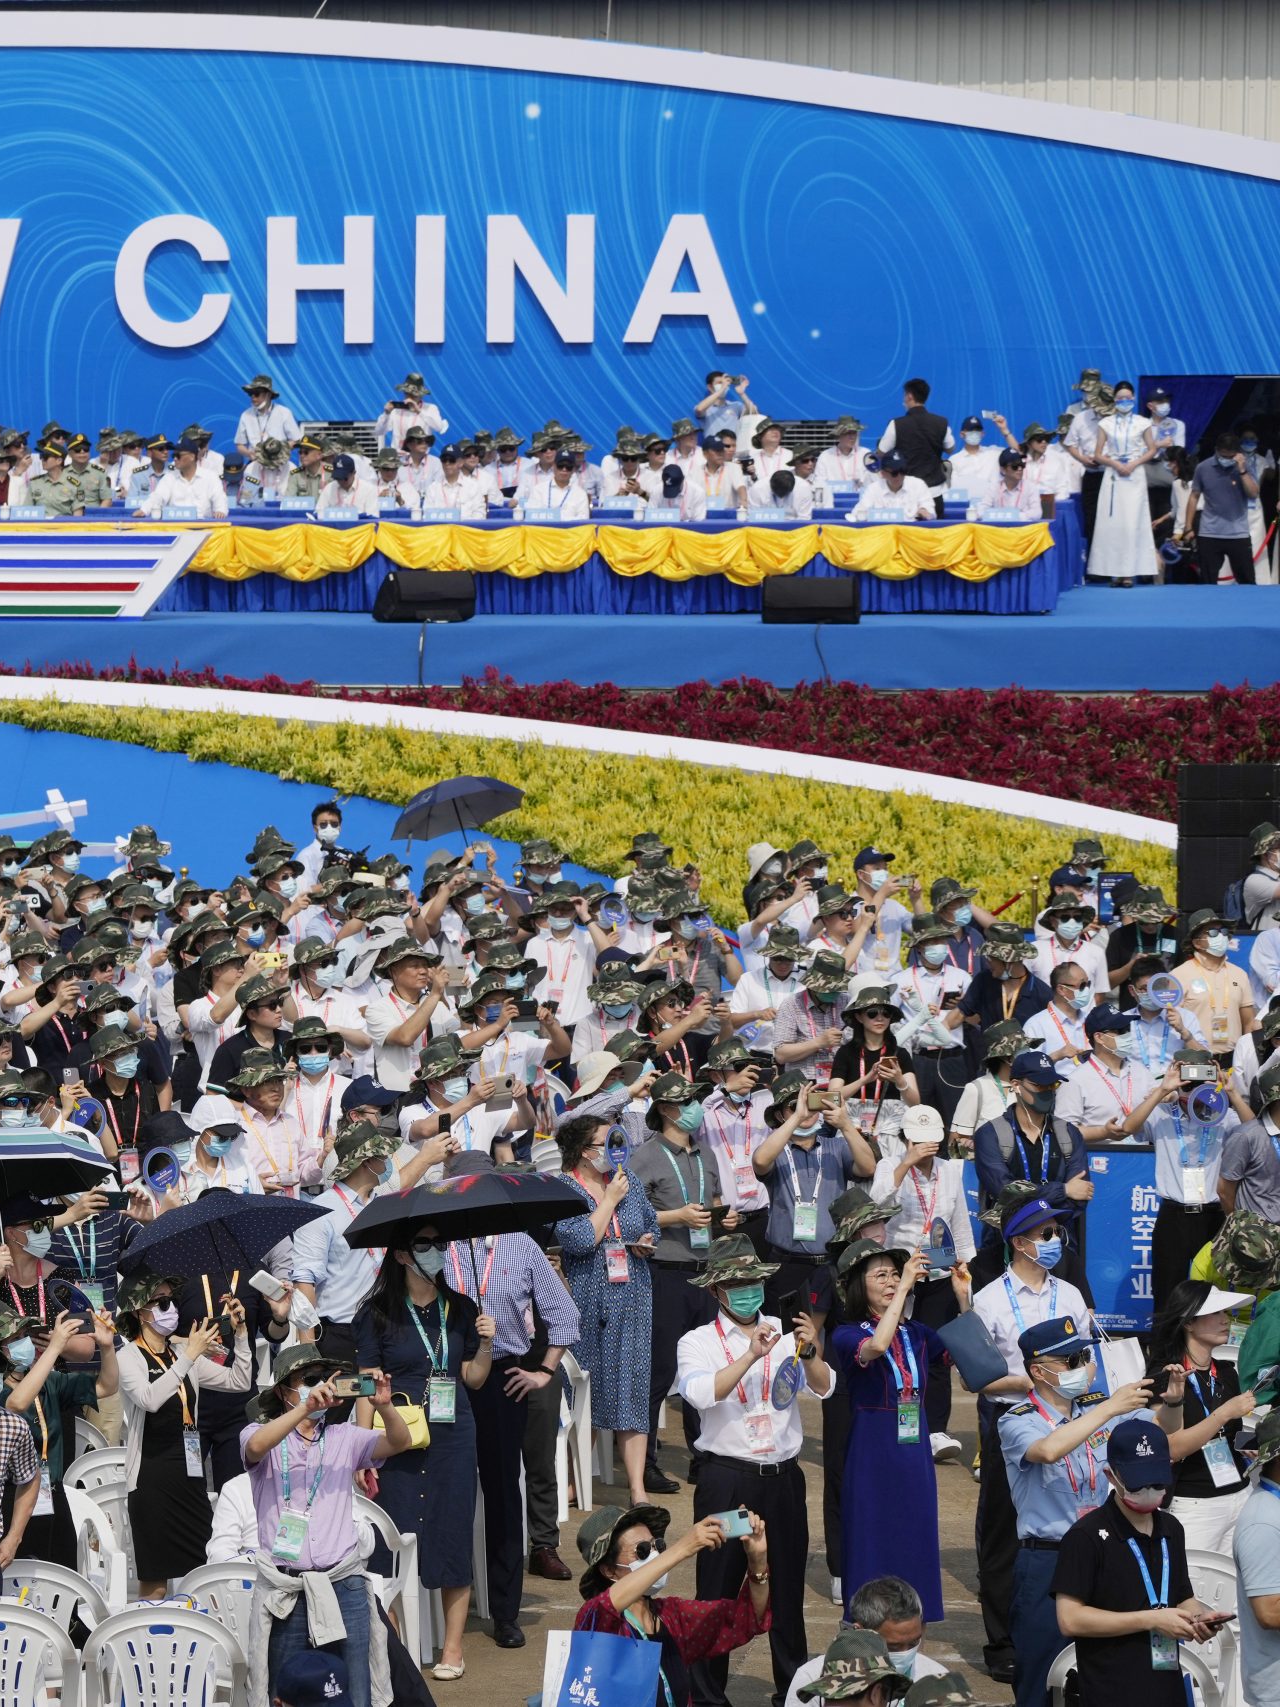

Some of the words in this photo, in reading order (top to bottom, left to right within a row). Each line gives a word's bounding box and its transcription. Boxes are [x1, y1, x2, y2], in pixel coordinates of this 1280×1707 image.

[113, 211, 748, 349] CHINA
[1130, 1184, 1160, 1299] 航空工业
[1117, 1318, 1139, 1327] CHINA
[569, 1677, 600, 1707] 航展
